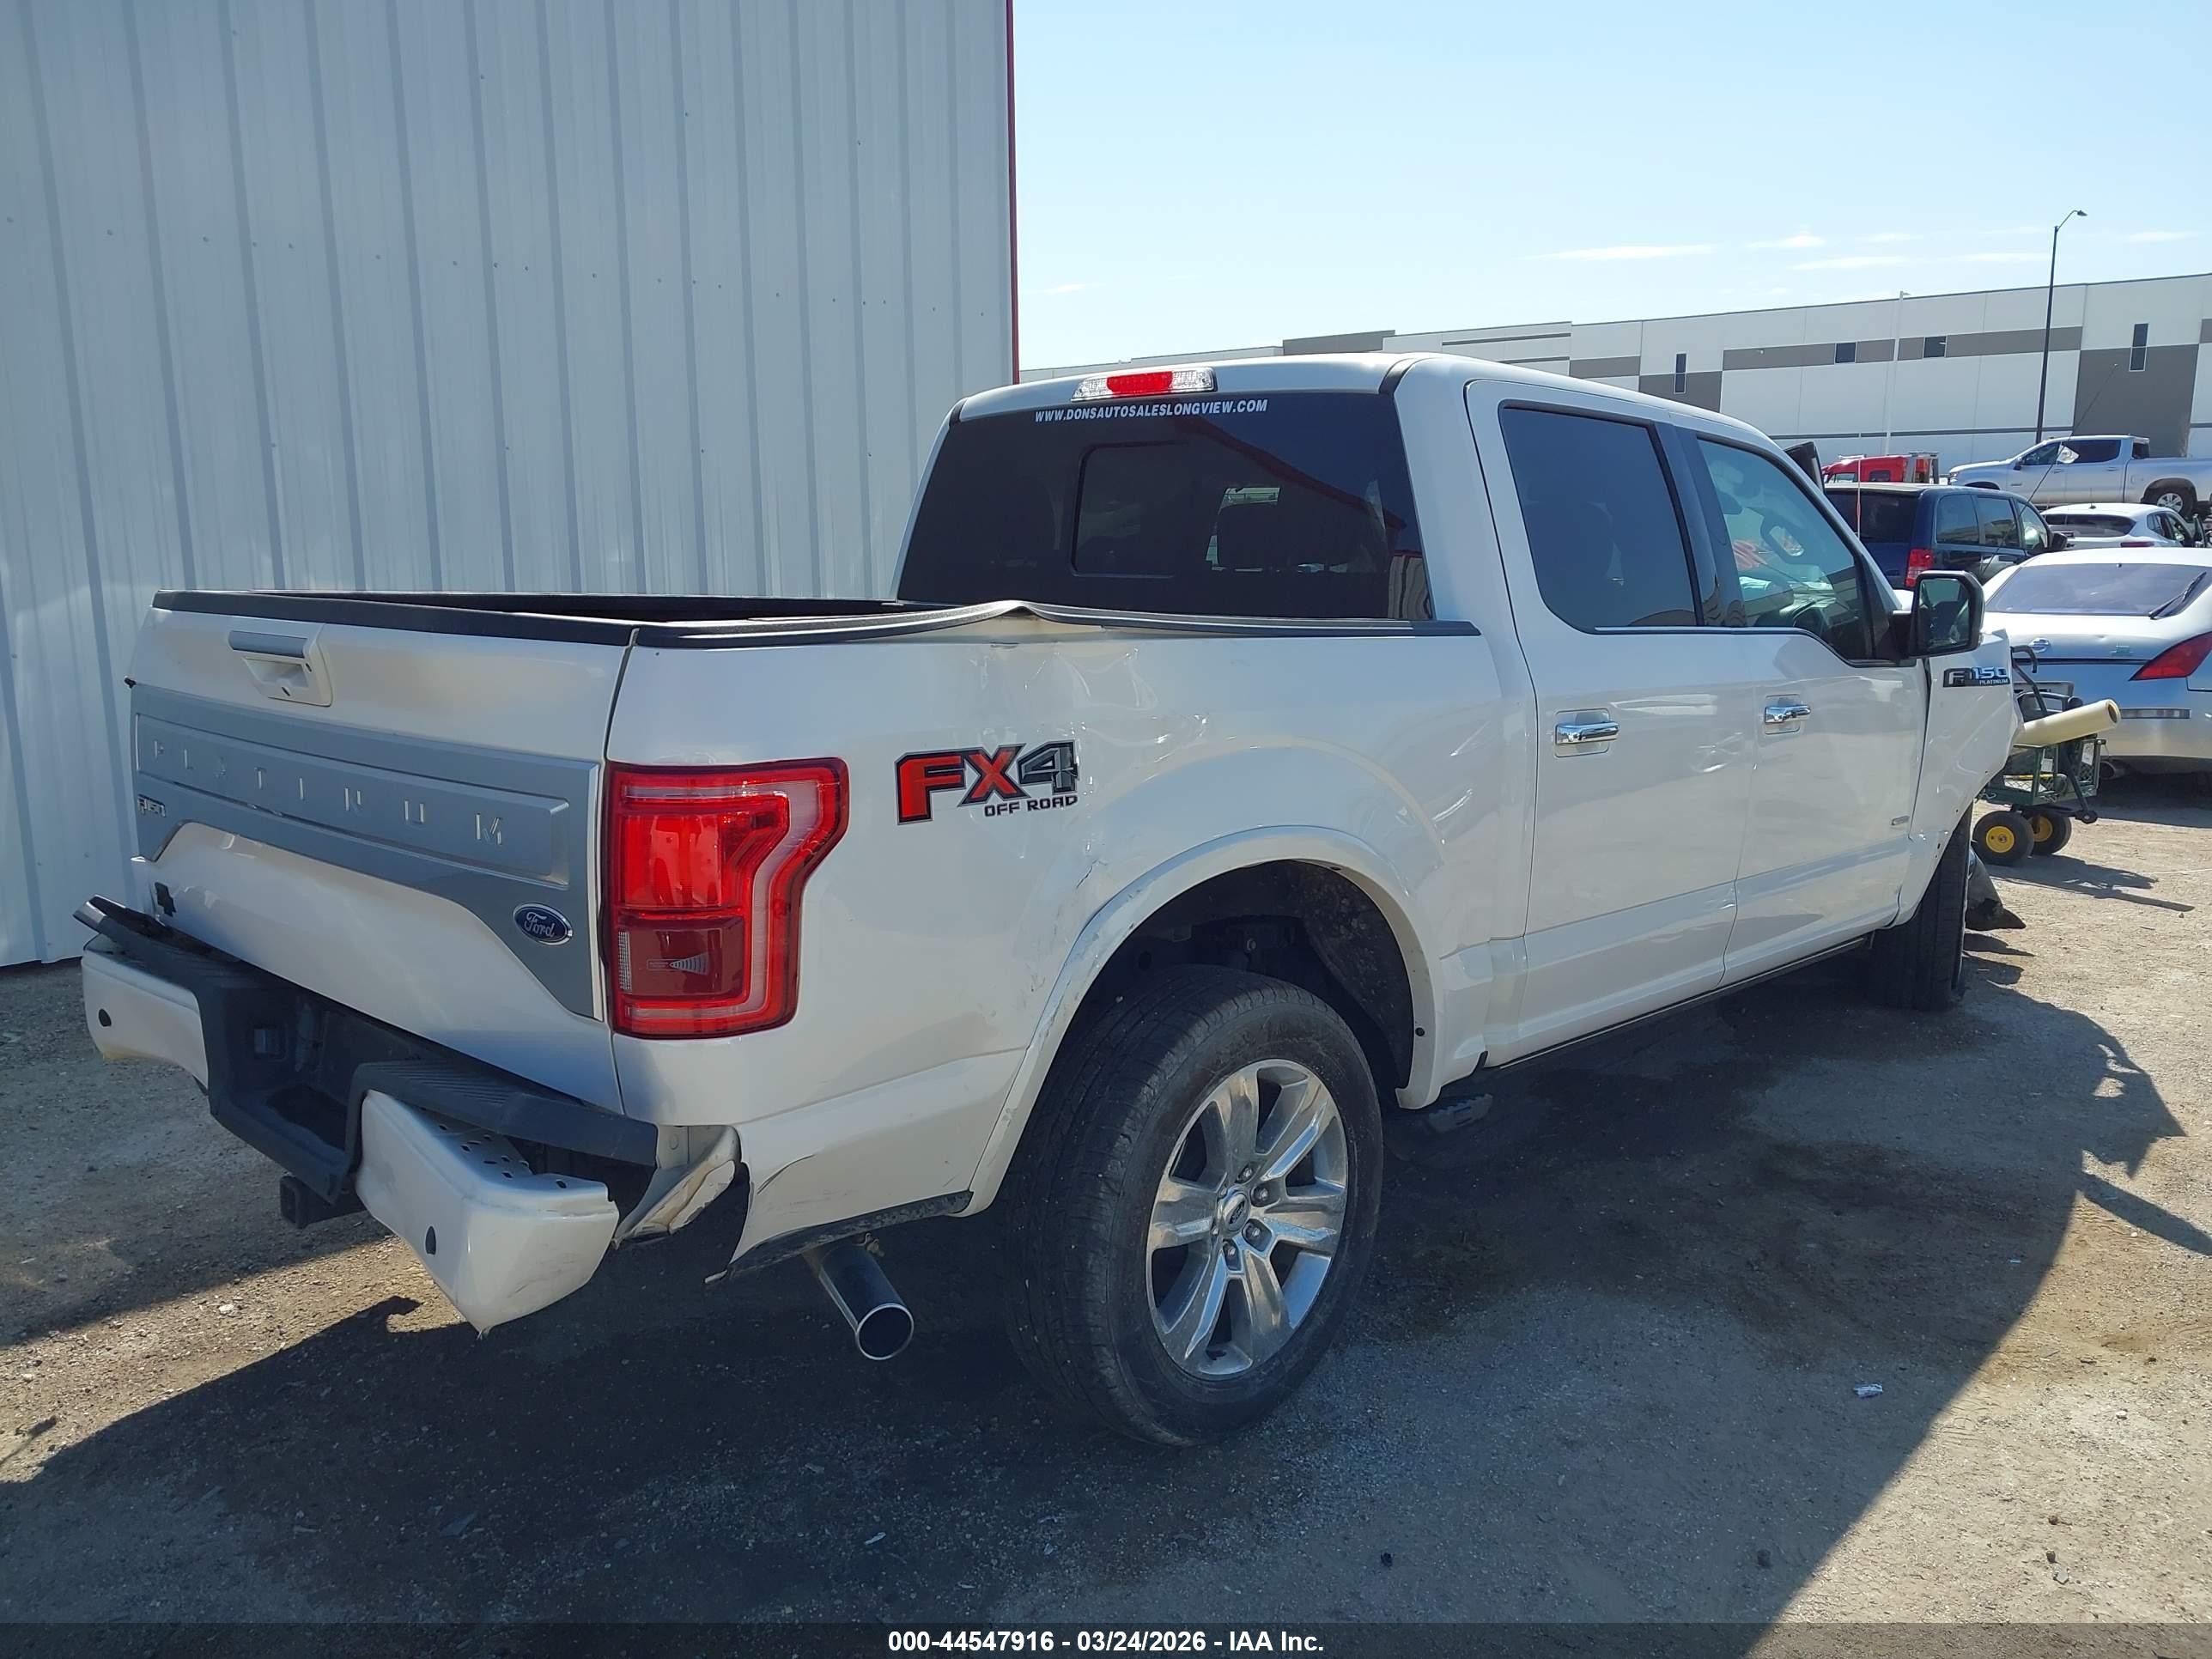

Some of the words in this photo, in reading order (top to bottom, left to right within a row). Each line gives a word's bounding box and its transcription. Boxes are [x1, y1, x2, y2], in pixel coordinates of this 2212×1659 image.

[1035, 399, 1268, 422] WWW.DONSAUTOSALESLONGVIEW.COM
[894, 738, 1080, 825] FX4
[984, 799, 1021, 817] OFF
[1027, 794, 1079, 812] ROAD
[524, 911, 556, 938] Ford
